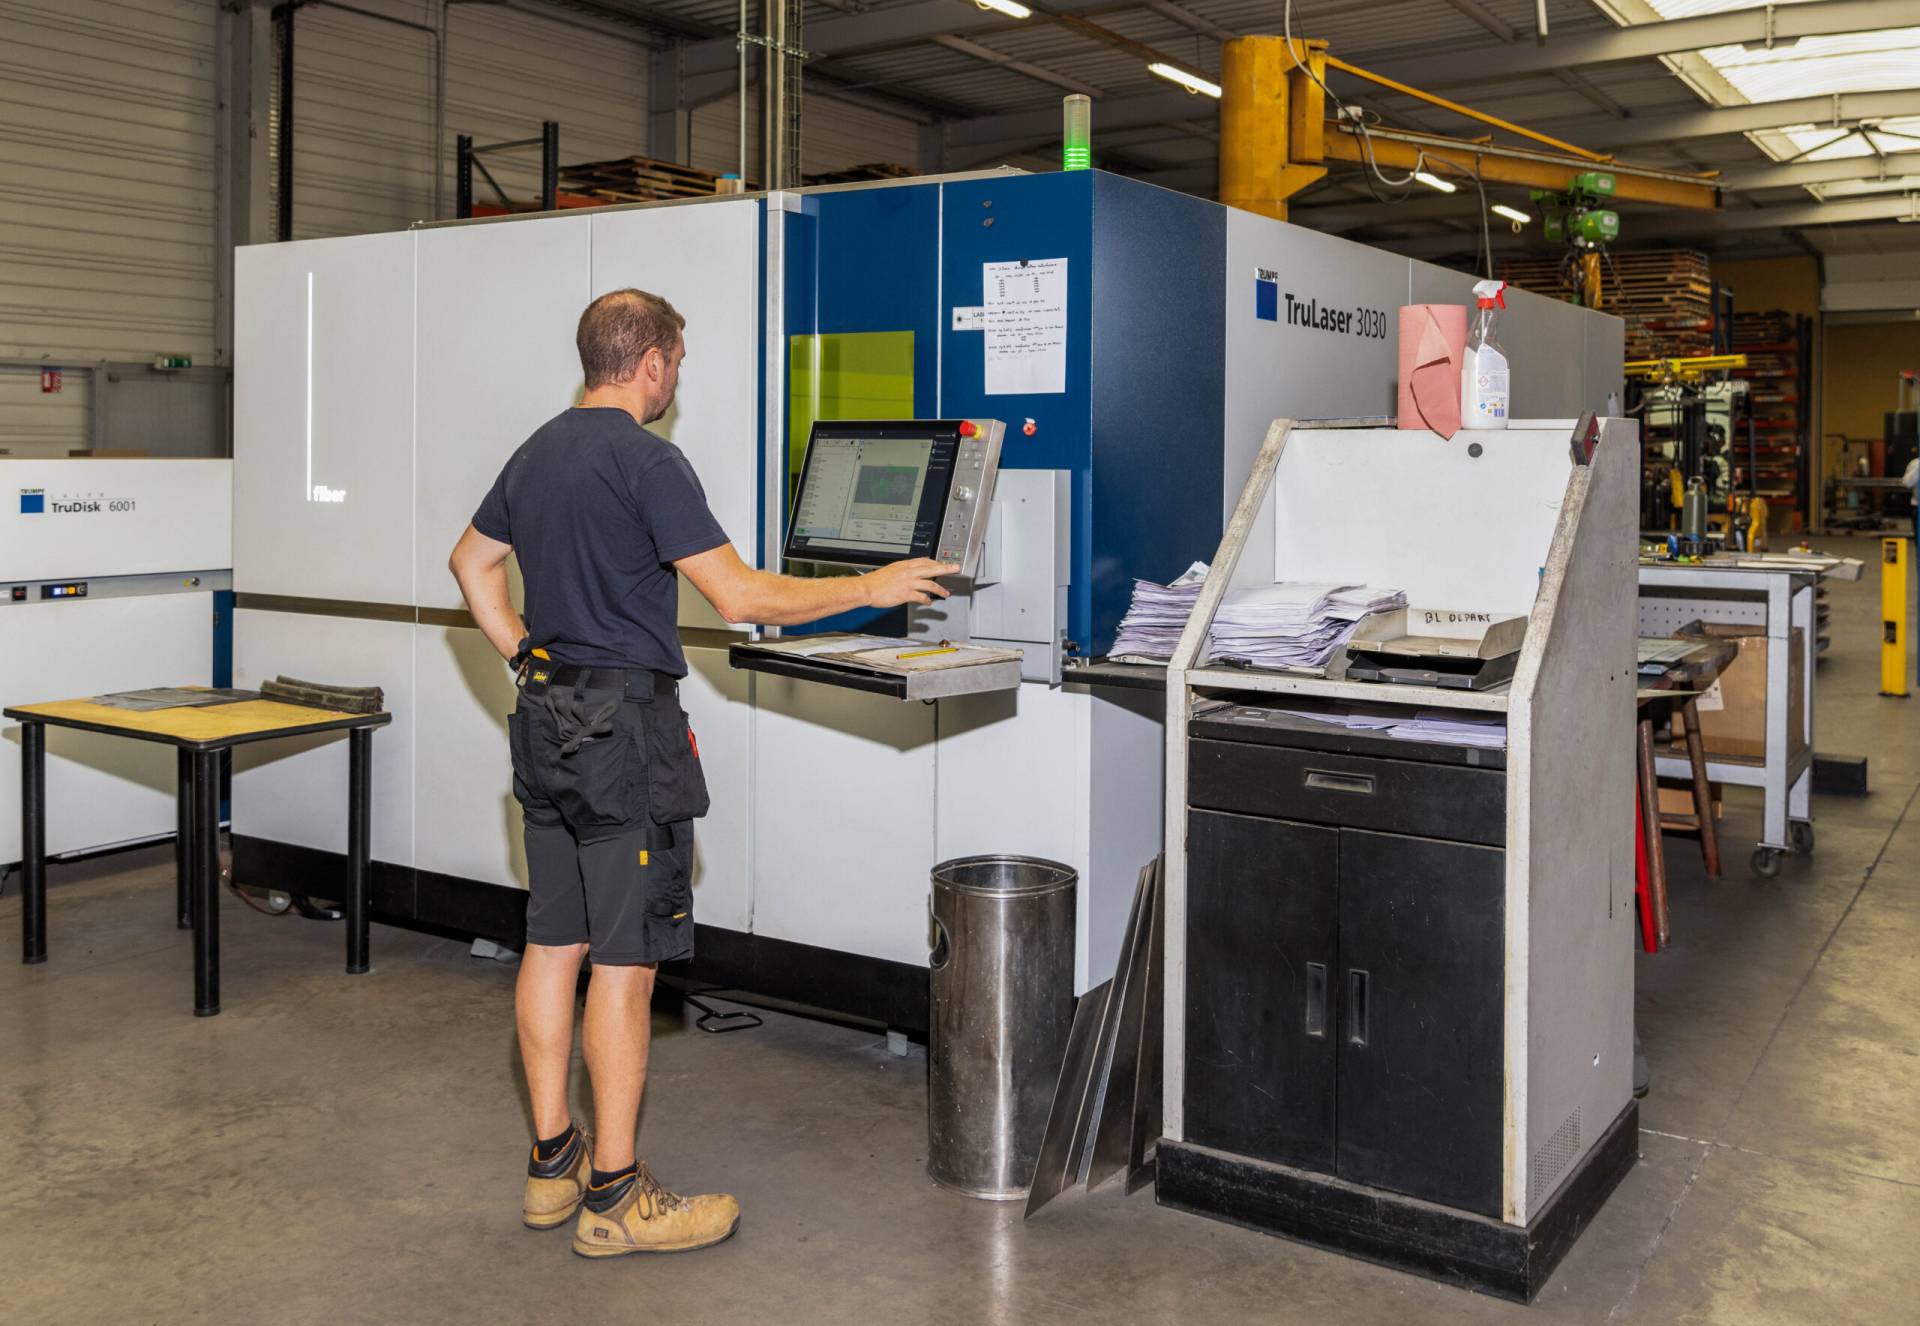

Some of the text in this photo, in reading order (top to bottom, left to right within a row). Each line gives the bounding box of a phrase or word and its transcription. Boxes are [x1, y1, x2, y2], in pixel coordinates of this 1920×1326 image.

[1285, 293, 1386, 339] TruLaser 3030
[51, 501, 135, 513] TruDisk 6001
[1425, 612, 1441, 623] BL
